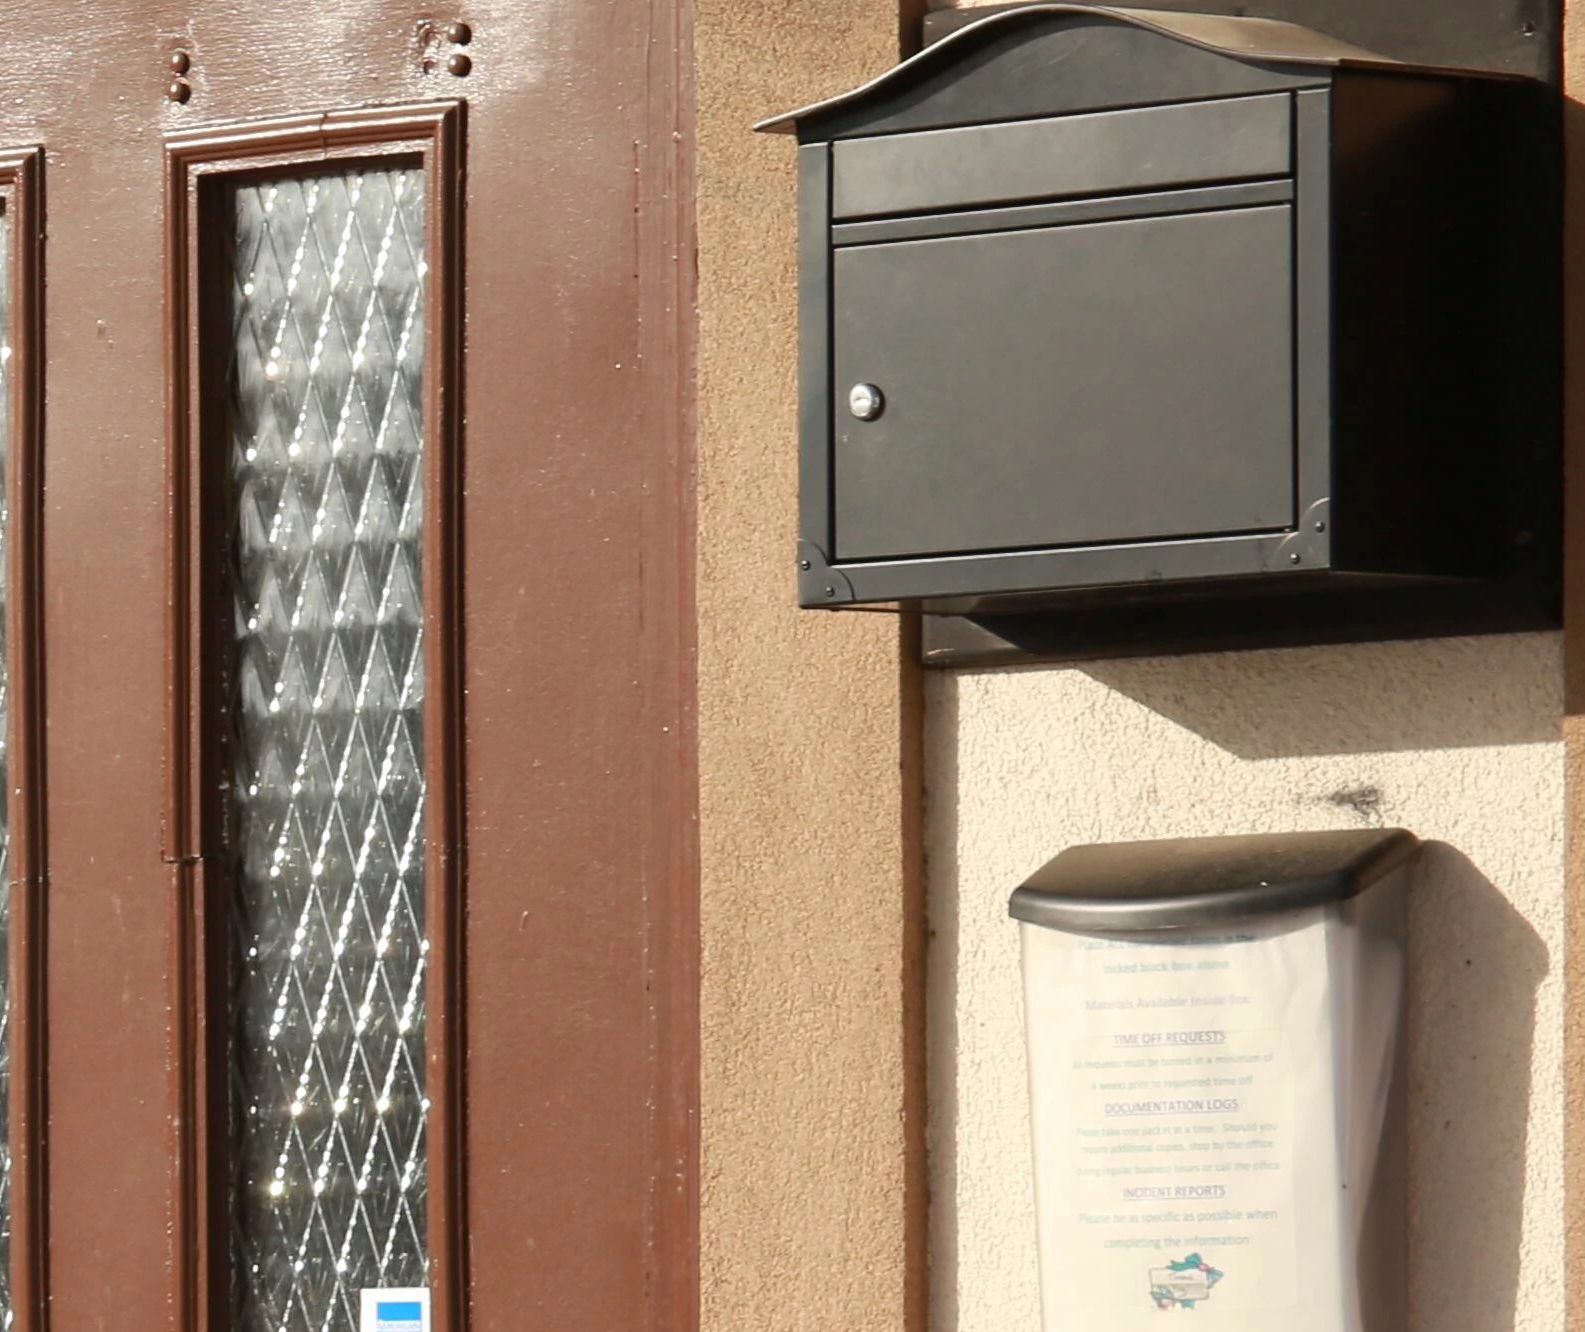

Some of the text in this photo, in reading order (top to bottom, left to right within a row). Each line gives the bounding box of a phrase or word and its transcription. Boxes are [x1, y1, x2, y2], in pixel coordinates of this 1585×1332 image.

[1114, 1030, 1227, 1046] TIME OFF REQUESTS
[1104, 1098, 1239, 1116] DOCUMENTATION LOGS
[1123, 1184, 1227, 1200] INCIDENT REPORTS
